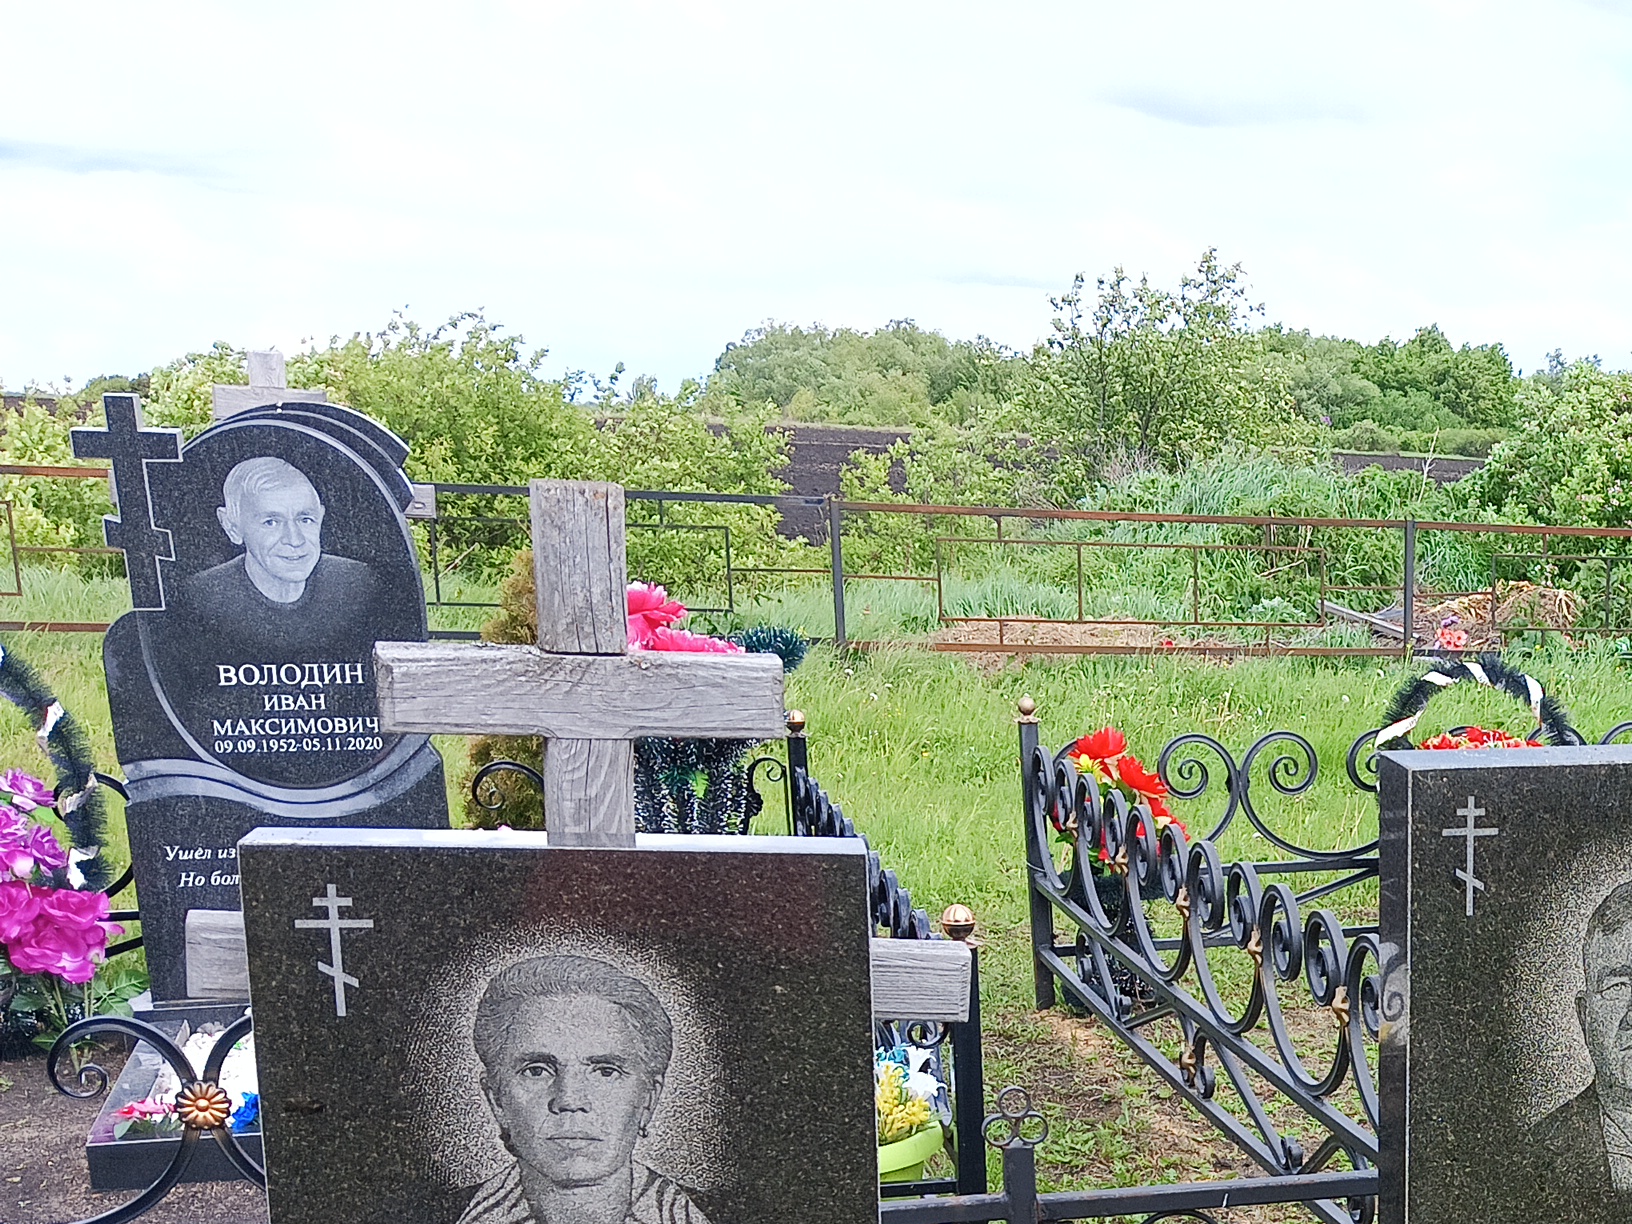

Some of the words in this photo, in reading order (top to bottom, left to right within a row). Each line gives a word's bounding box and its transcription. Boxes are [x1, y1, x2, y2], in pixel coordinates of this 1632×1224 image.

[216, 663, 365, 688] ВОЛОДИН
[263, 694, 326, 712] ИВАН
[211, 717, 379, 736] МАКСИМОВИЧ
[218, 848, 236, 859] из
[178, 871, 206, 888] Но
